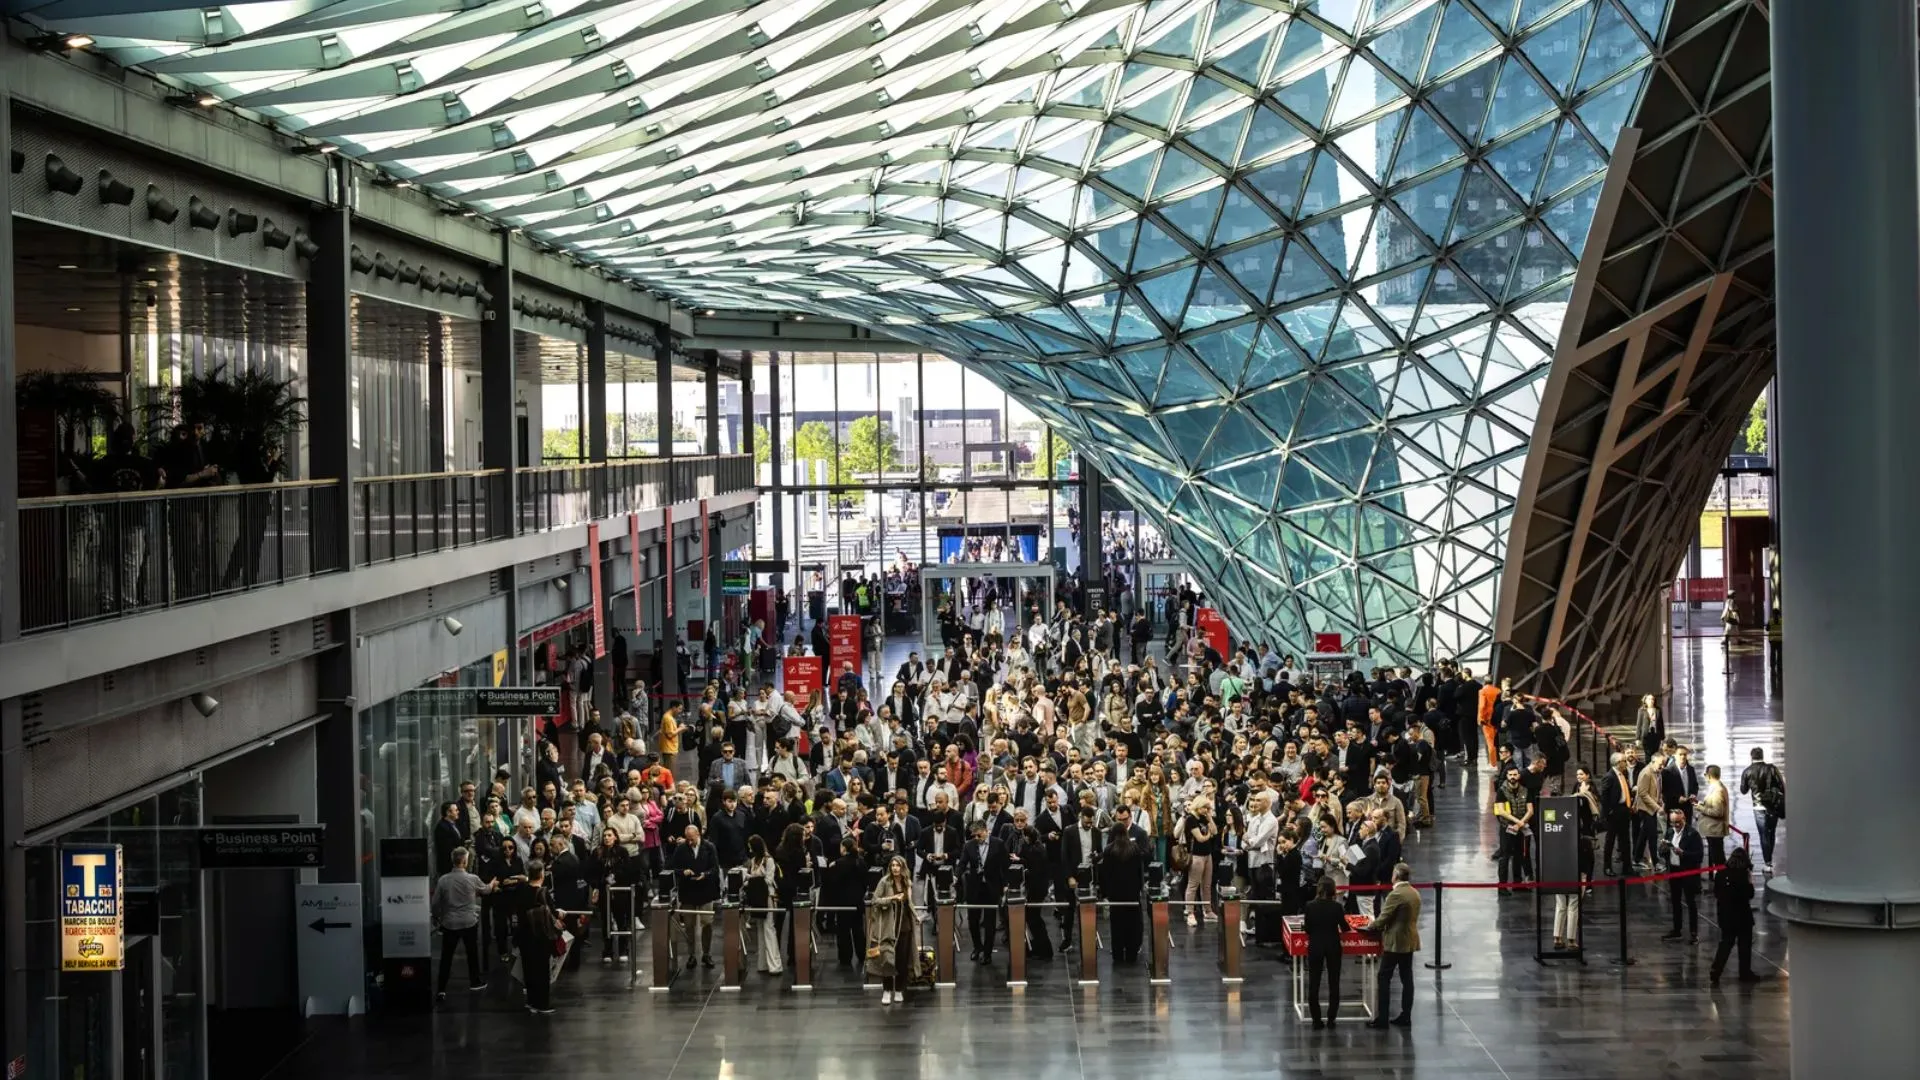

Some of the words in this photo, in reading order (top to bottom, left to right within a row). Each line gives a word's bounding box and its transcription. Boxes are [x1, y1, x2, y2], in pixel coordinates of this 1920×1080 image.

[487, 691, 529, 700] Business
[532, 691, 556, 700] Point
[1544, 823, 1564, 832] Bar
[215, 832, 278, 844] Business
[281, 832, 316, 844] Point
[72, 854, 106, 897] T
[65, 900, 115, 913] TABACCHI
[89, 917, 97, 925] DA
[97, 917, 116, 925] BOLLO
[64, 927, 87, 936] RICARICHE
[64, 960, 77, 968] SELF
[78, 960, 98, 968] SERVICE
